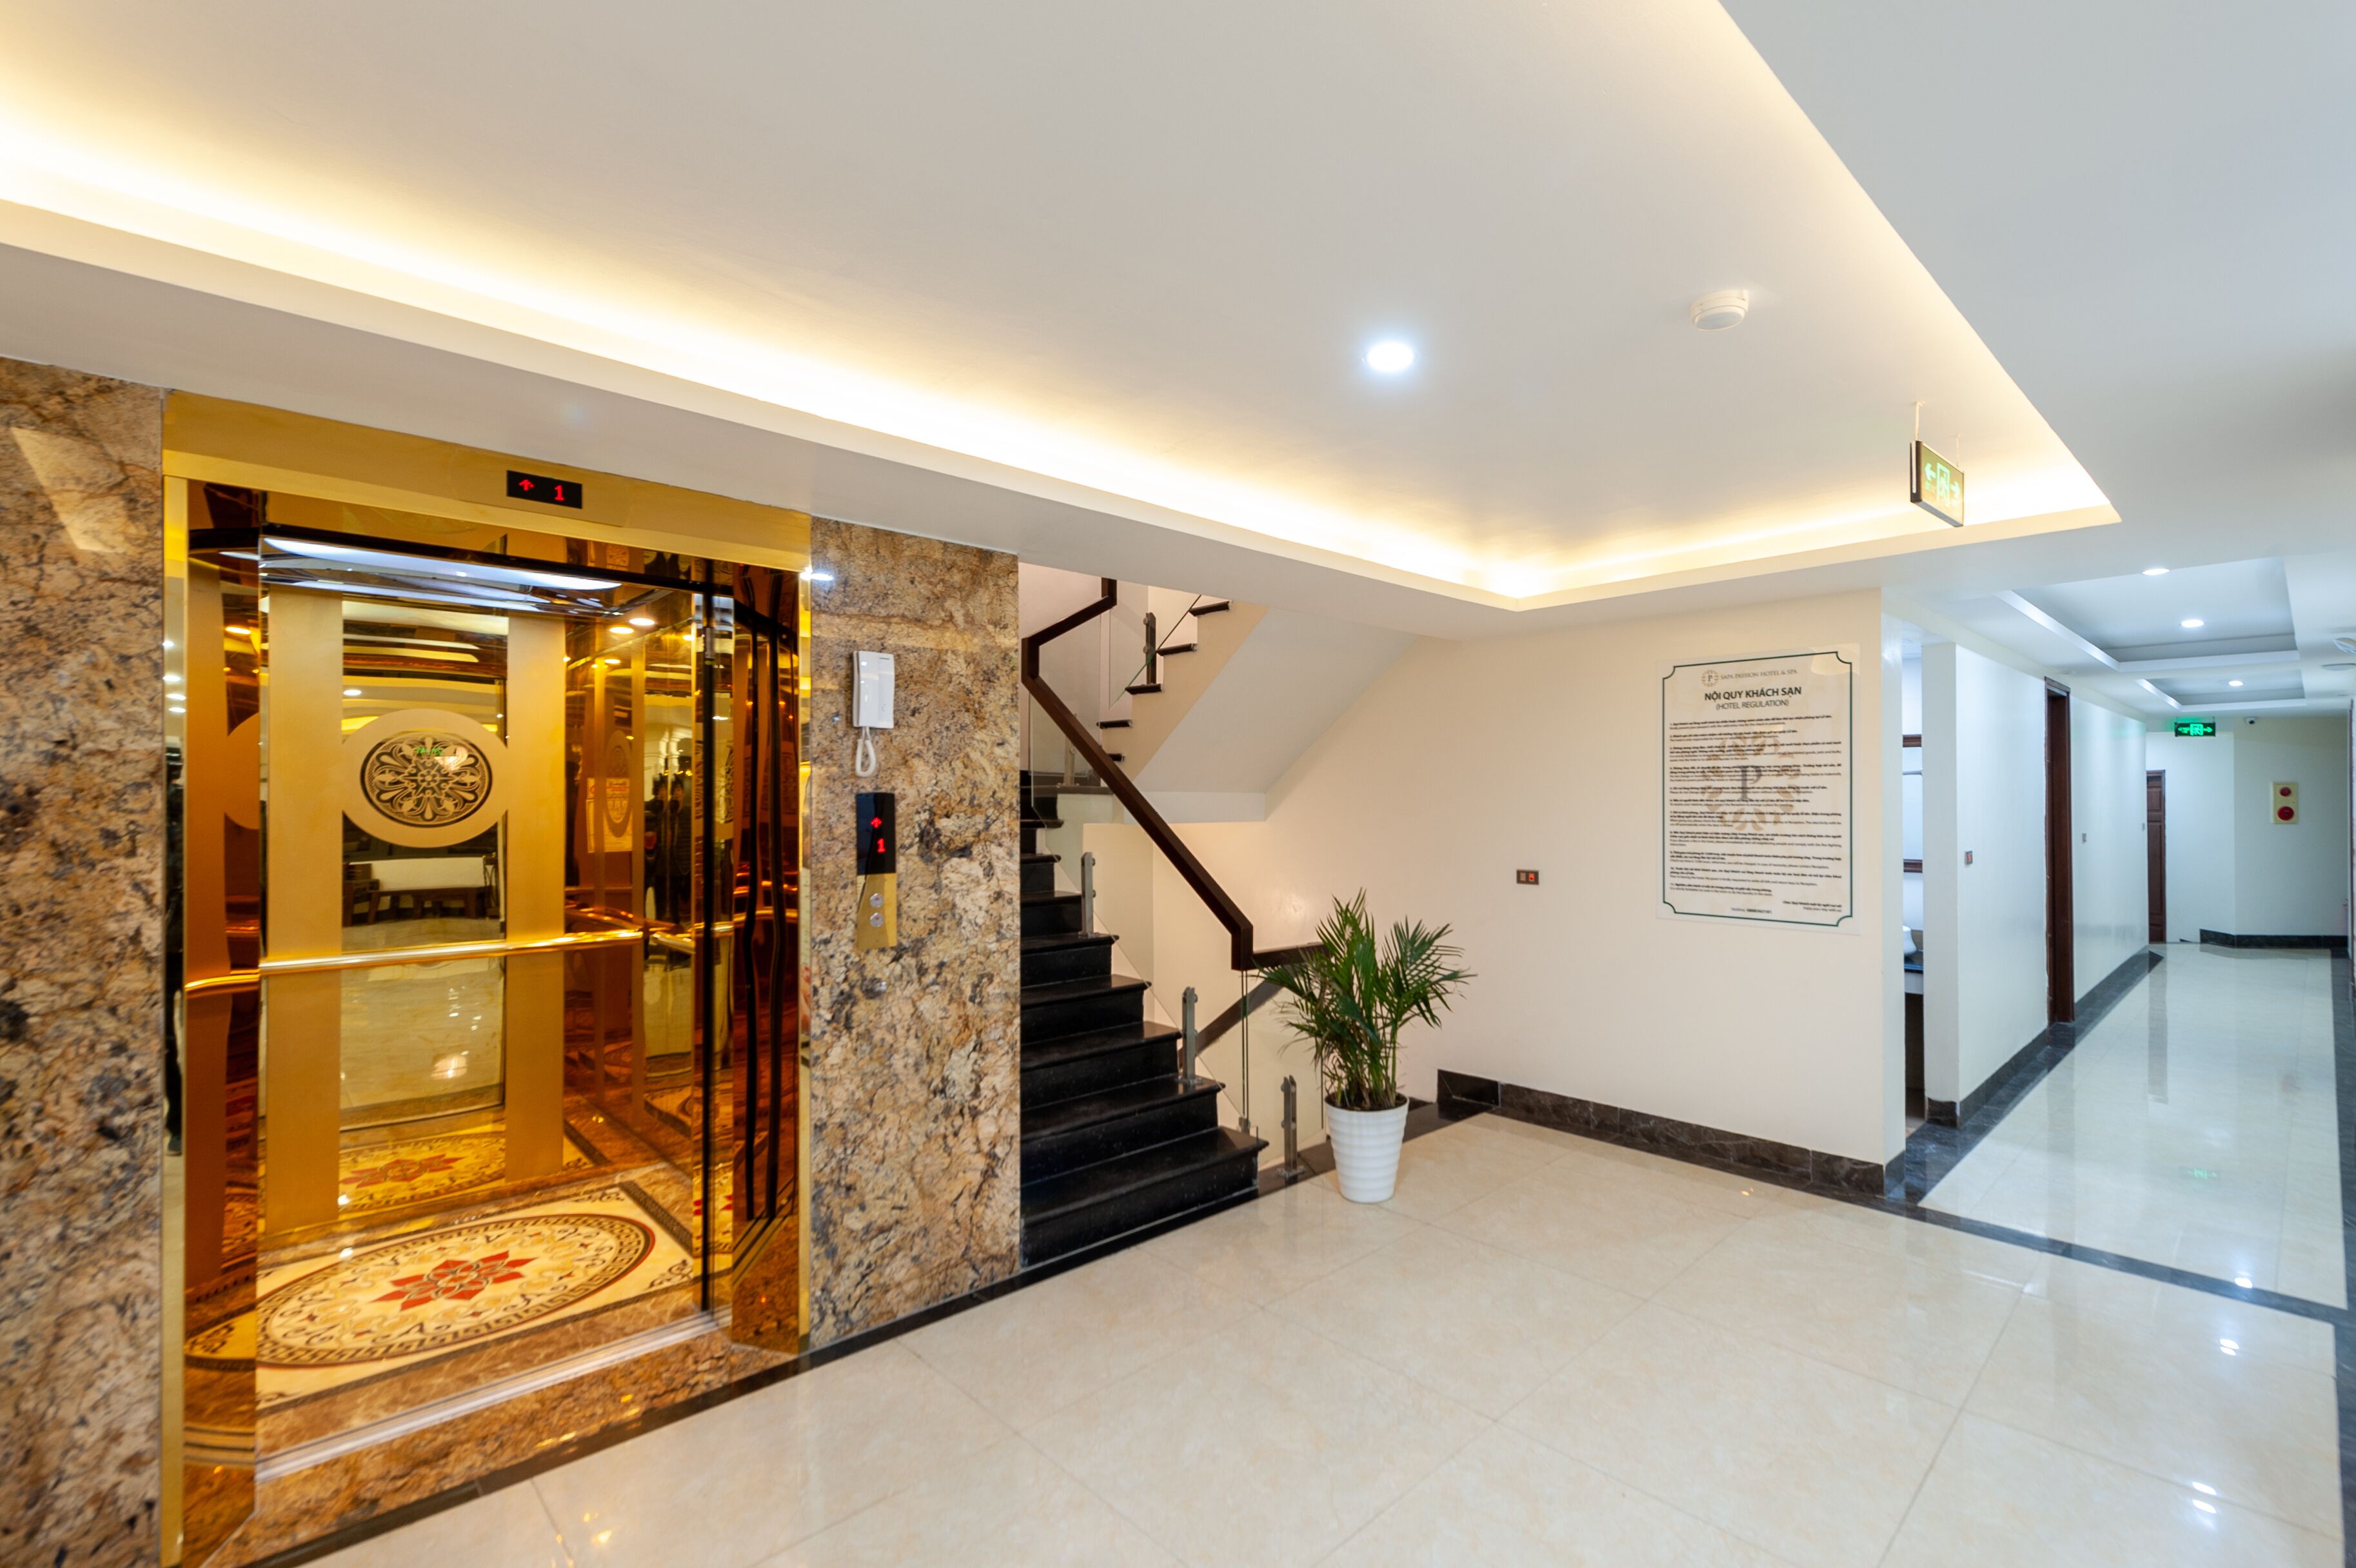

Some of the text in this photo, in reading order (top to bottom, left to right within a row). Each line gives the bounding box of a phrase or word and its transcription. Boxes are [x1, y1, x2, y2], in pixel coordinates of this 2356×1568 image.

[555, 485, 565, 501] 1
[1705, 686, 1802, 702] NỘI QUY KHÁCH SẠN
[1741, 699, 1790, 708] REGULATION)
[877, 838, 886, 853] 1
